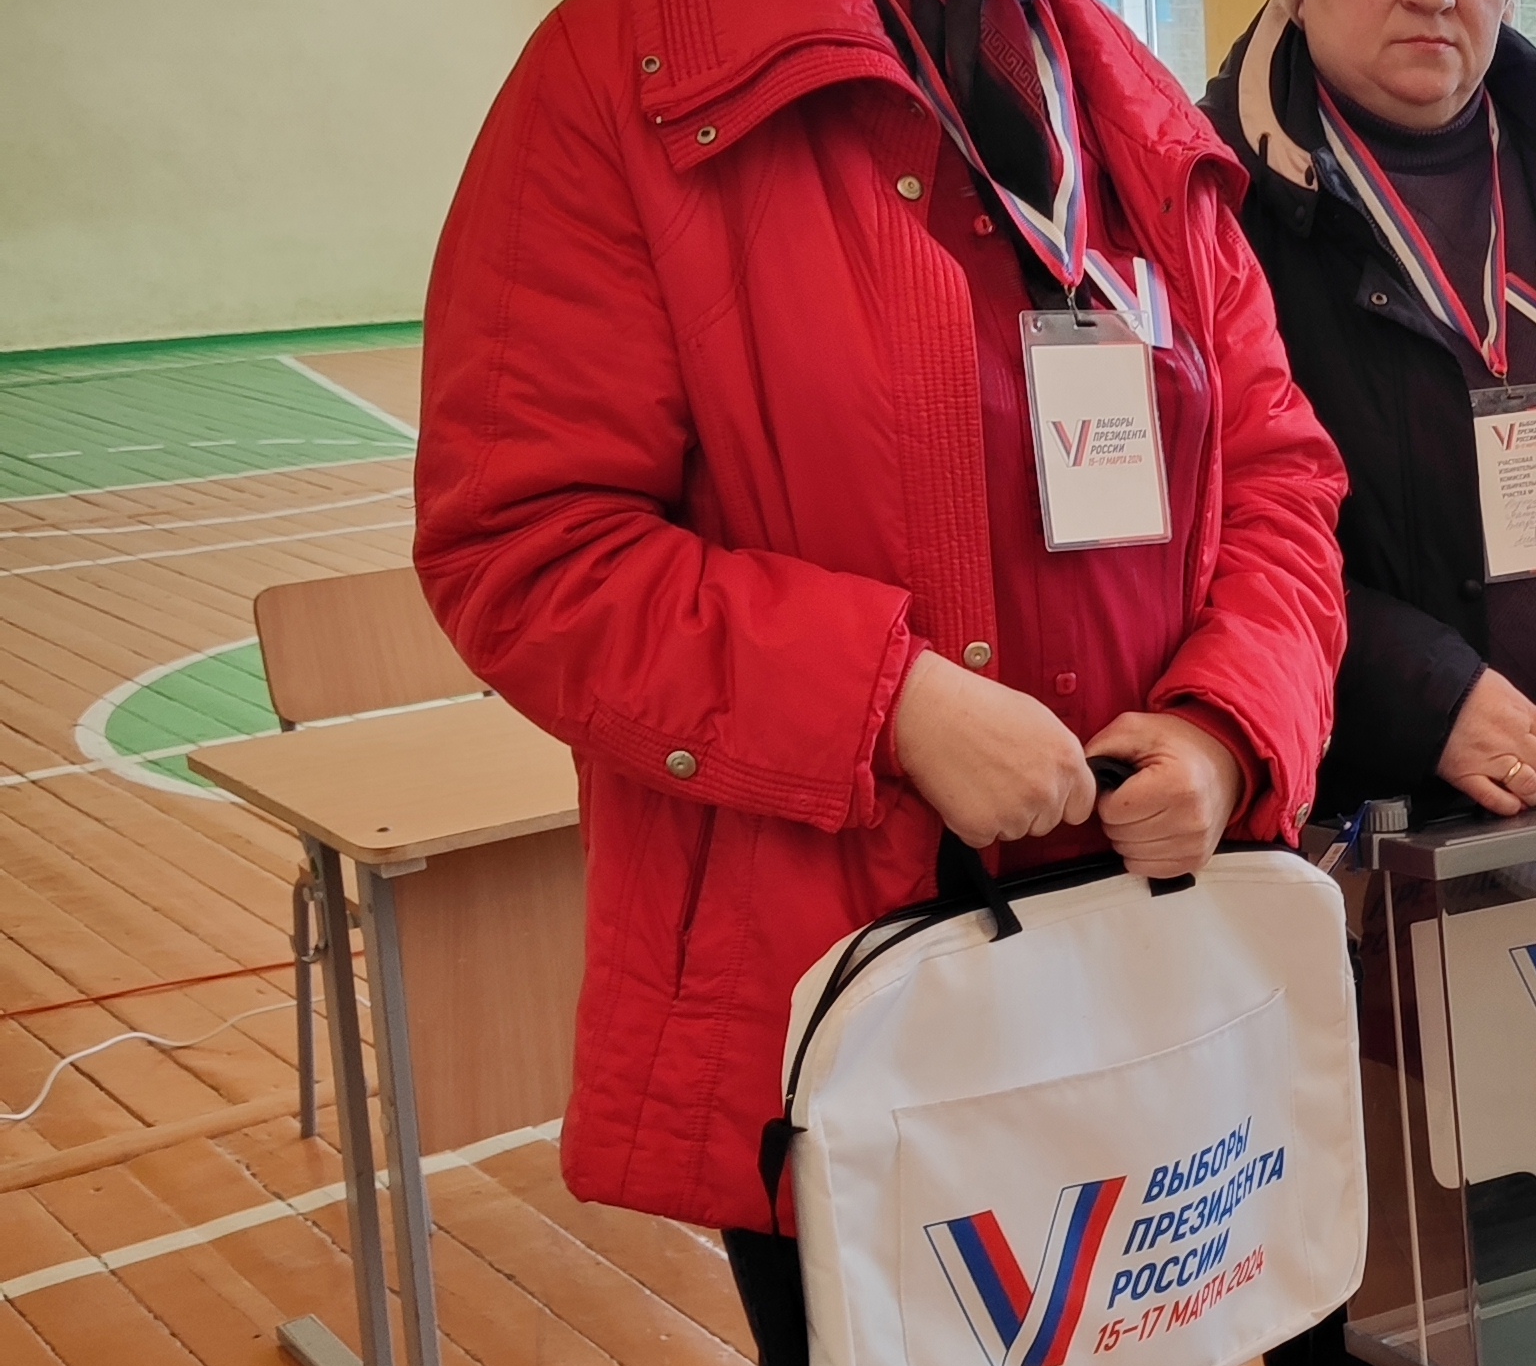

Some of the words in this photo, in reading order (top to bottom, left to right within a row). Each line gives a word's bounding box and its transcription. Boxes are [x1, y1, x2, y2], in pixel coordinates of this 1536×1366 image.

[1090, 443, 1125, 455] РОССИИ
[1093, 429, 1147, 442] ПРЕЗИДЕНТА
[1096, 417, 1134, 429] ВЫБОРЫ
[1122, 1146, 1285, 1256] ПРЕЗИДЕНТА
[1142, 1115, 1252, 1204] ВЫБОРЫ
[1107, 1227, 1231, 1310] РОССИИ
[1165, 1276, 1225, 1332] МАРТА
[1225, 1244, 1264, 1296] 2024
